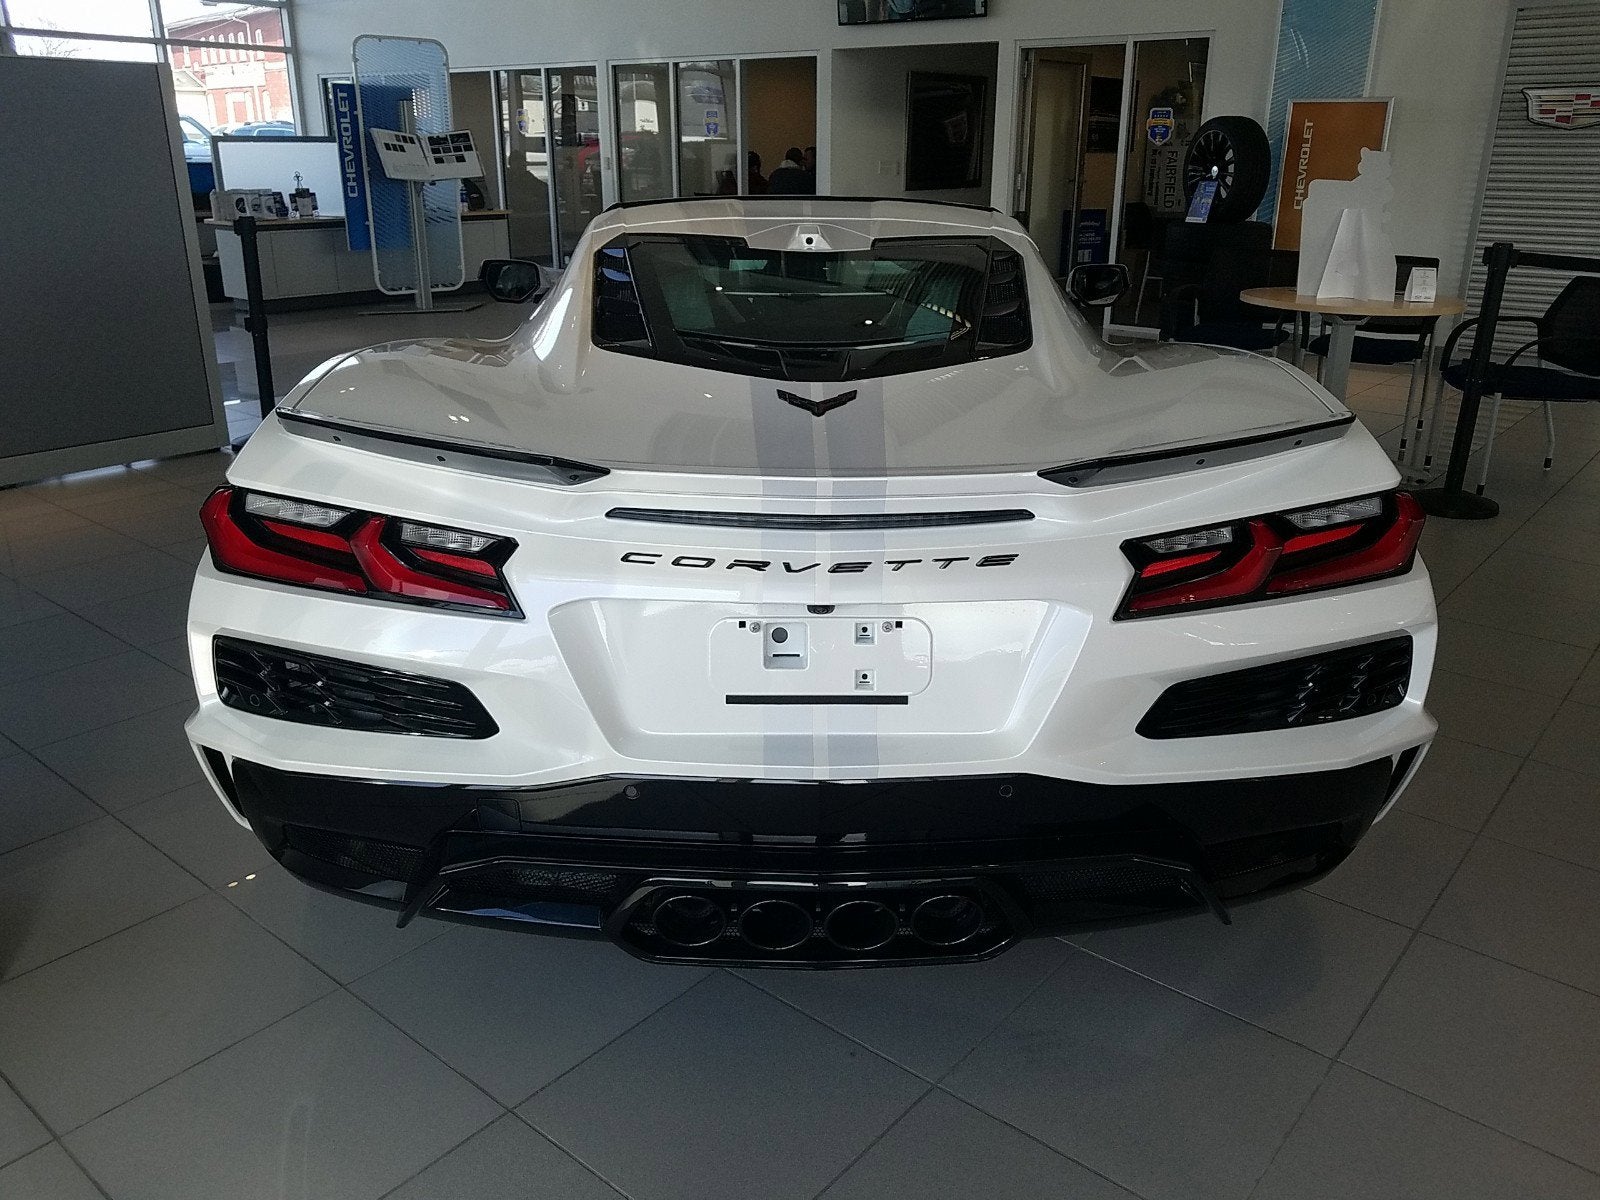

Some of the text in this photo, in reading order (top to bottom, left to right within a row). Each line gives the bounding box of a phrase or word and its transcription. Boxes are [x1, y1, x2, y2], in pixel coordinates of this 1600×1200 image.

[337, 88, 359, 198] CHEVROLET
[1163, 150, 1179, 208] FAIRFIELD
[1293, 118, 1314, 210] CHEVROLET
[620, 551, 1020, 575] CORVETTE
